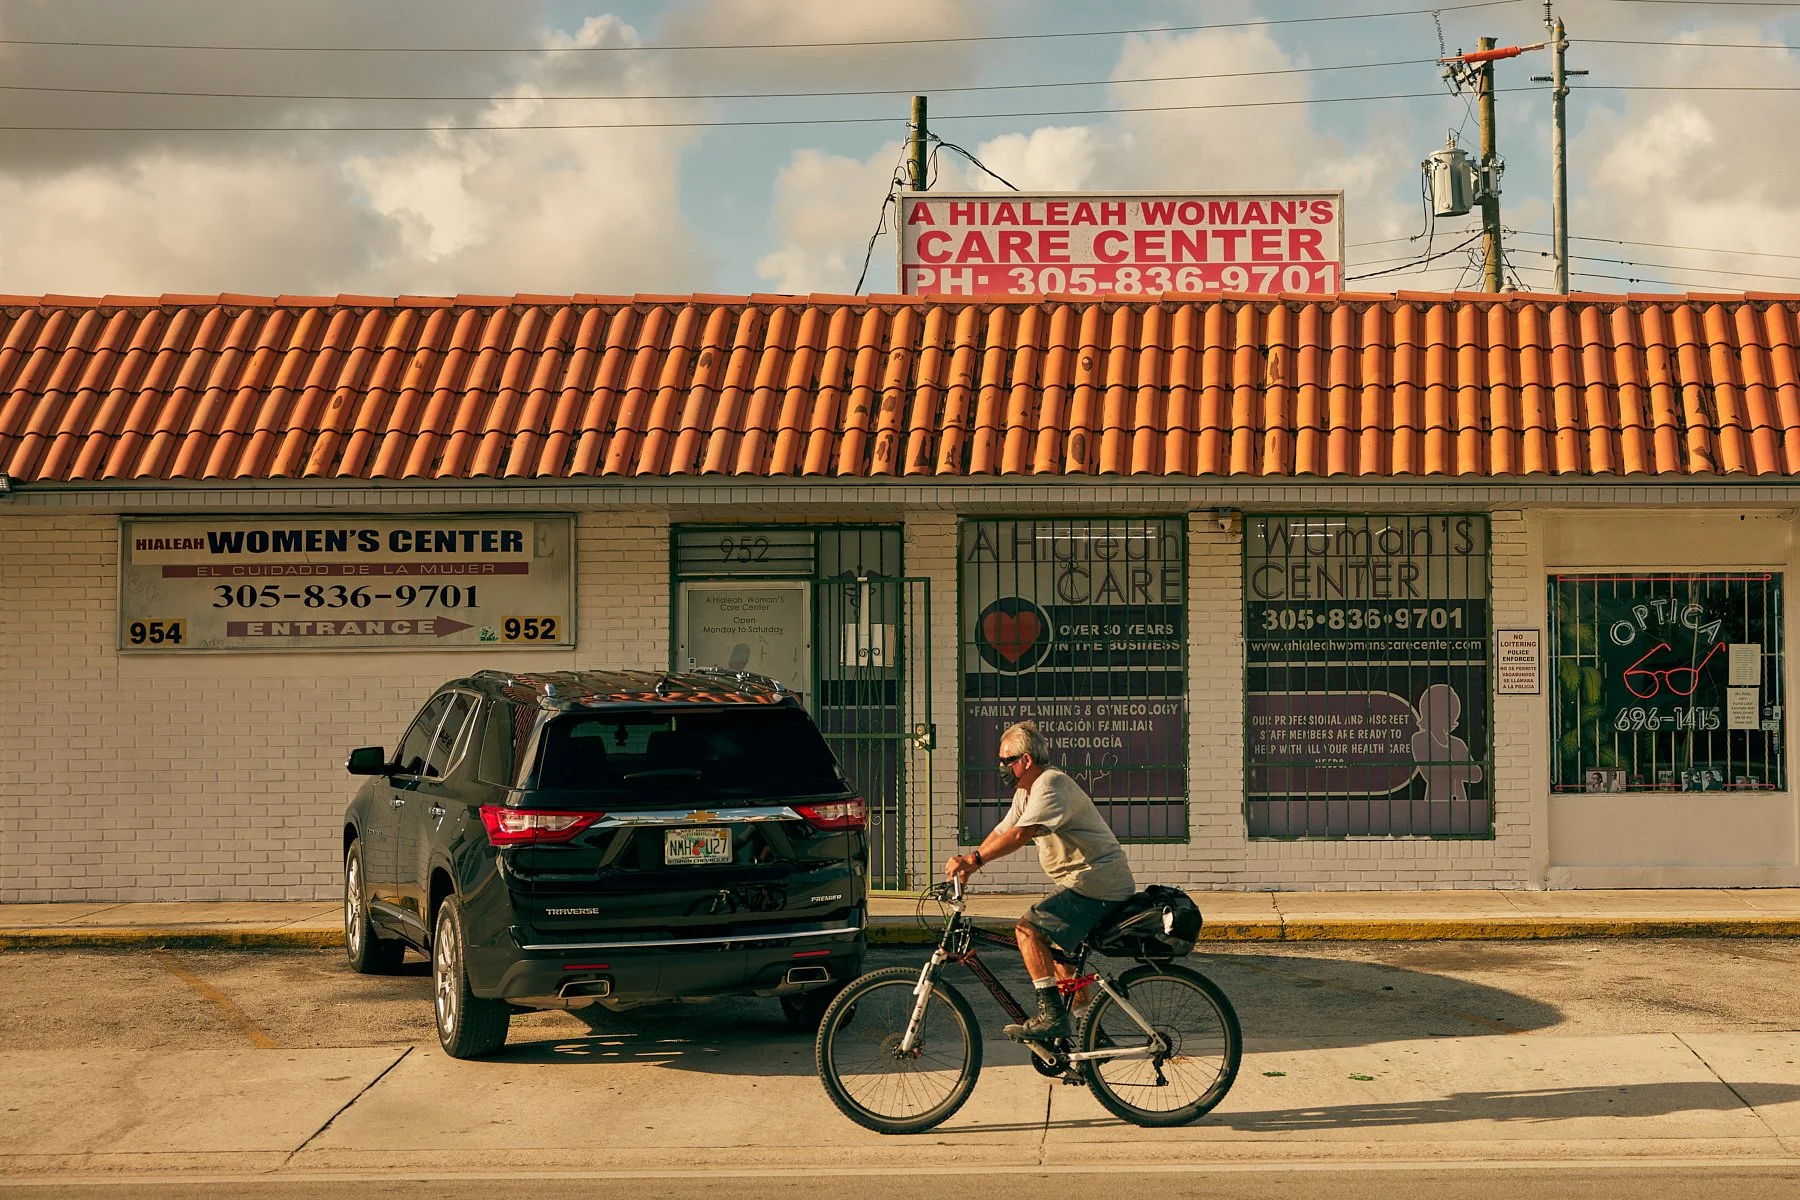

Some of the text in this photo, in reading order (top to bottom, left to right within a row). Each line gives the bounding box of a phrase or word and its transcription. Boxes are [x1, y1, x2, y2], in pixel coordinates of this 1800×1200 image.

[907, 200, 1333, 226] A HIALEAH WOMAN'S
[917, 229, 1325, 263] CARE CENTER
[1008, 265, 1334, 295] 305-836-9701
[136, 529, 523, 554] HIALEAH WOMEN'S CENTER
[720, 536, 770, 563] 952
[967, 527, 998, 561] A
[197, 564, 495, 576] EL CUIDADO DE LA MUJER
[1251, 562, 1421, 600] CENTER
[212, 584, 481, 609] 305-836-9701
[1057, 567, 1181, 604] CARE
[742, 603, 770, 611] Center
[247, 620, 435, 637] ENTRANCE
[504, 618, 556, 640] 952
[703, 626, 736, 634] Monday
[748, 625, 784, 635] Saturday
[733, 616, 756, 625] Open
[1059, 624, 1100, 636] OVER
[1125, 624, 1174, 635] YEARS
[1609, 598, 1722, 646] OPTICA
[130, 622, 182, 644] 954
[1084, 704, 1092, 716] &
[1096, 703, 1178, 716] GYNECOOGY
[1613, 706, 1721, 731] 696-1415
[1260, 729, 1287, 740] SAFF
[1357, 729, 1388, 740] READY
[1388, 729, 1402, 739] TO
[1254, 743, 1277, 755] HEP
[1351, 743, 1384, 754] HEALTH
[670, 837, 727, 856] NMH U27
[545, 907, 600, 915] TRAVERSE
